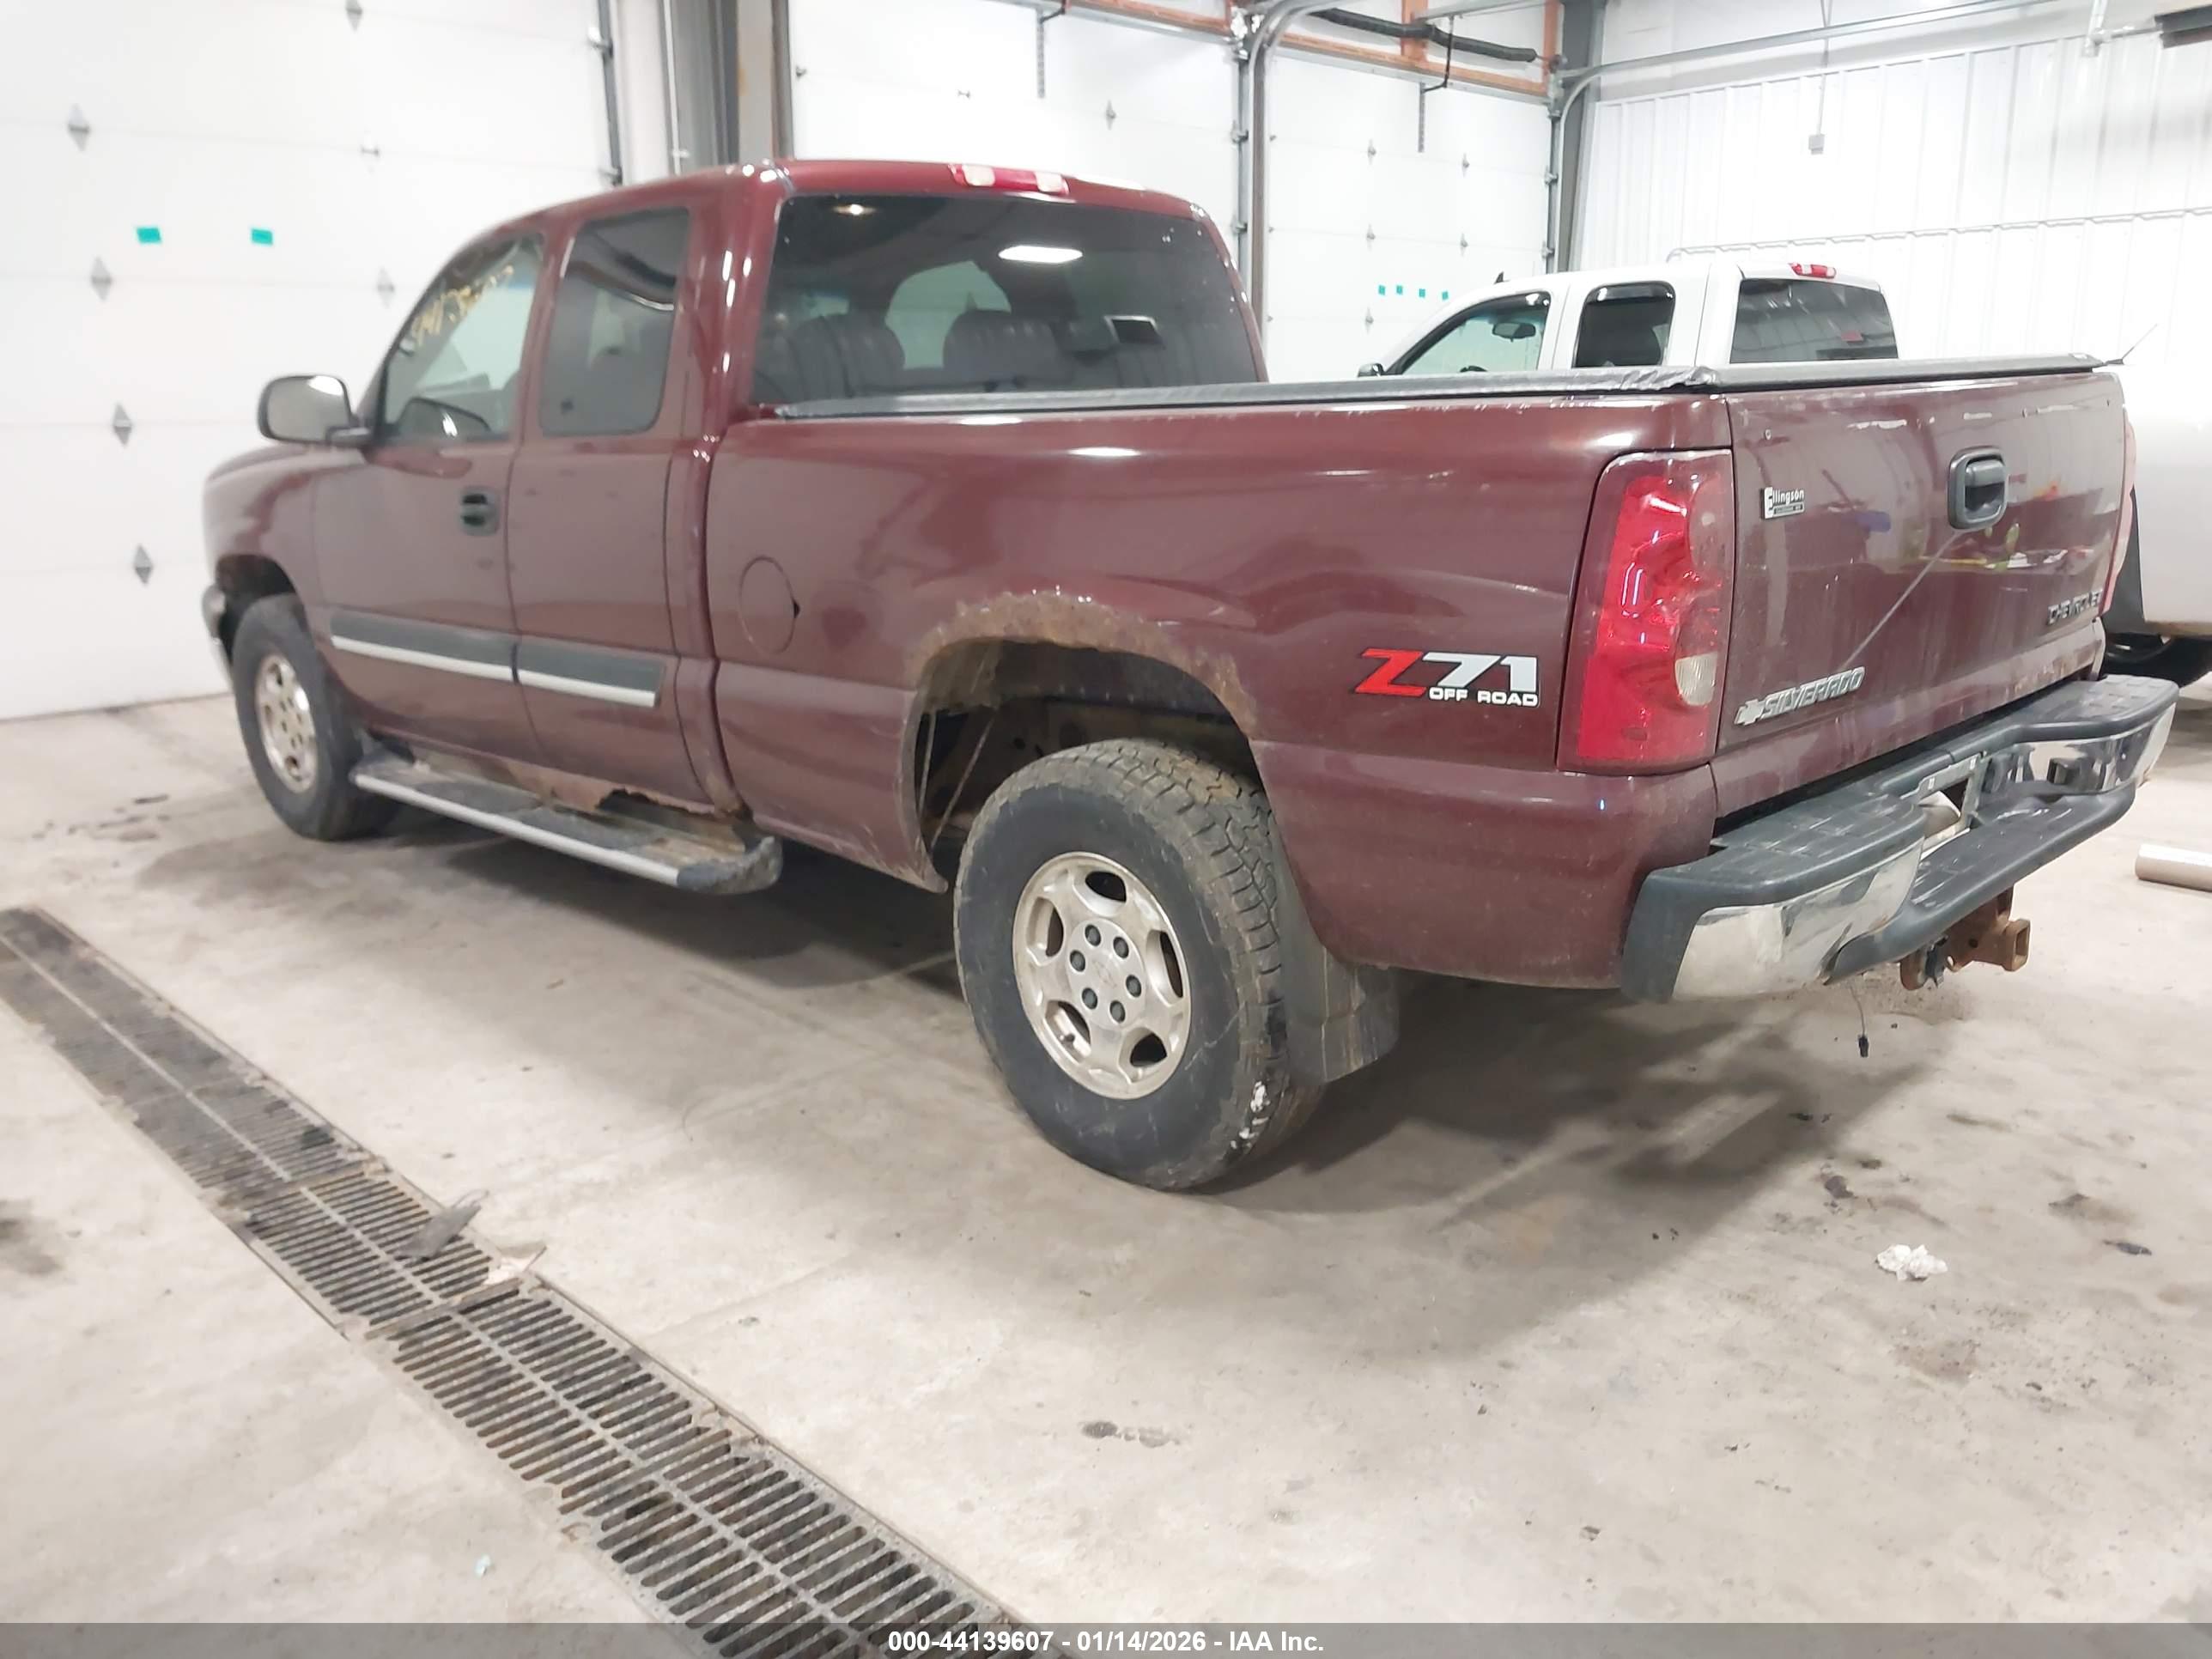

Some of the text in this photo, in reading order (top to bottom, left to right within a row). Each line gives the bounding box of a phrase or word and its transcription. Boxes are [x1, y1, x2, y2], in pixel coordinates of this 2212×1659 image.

[1765, 487, 1804, 519] Ellingson
[1354, 647, 1539, 697] Z71
[1429, 687, 1539, 708] OFF ROAD
[1760, 666, 1865, 720] SILVERADO
